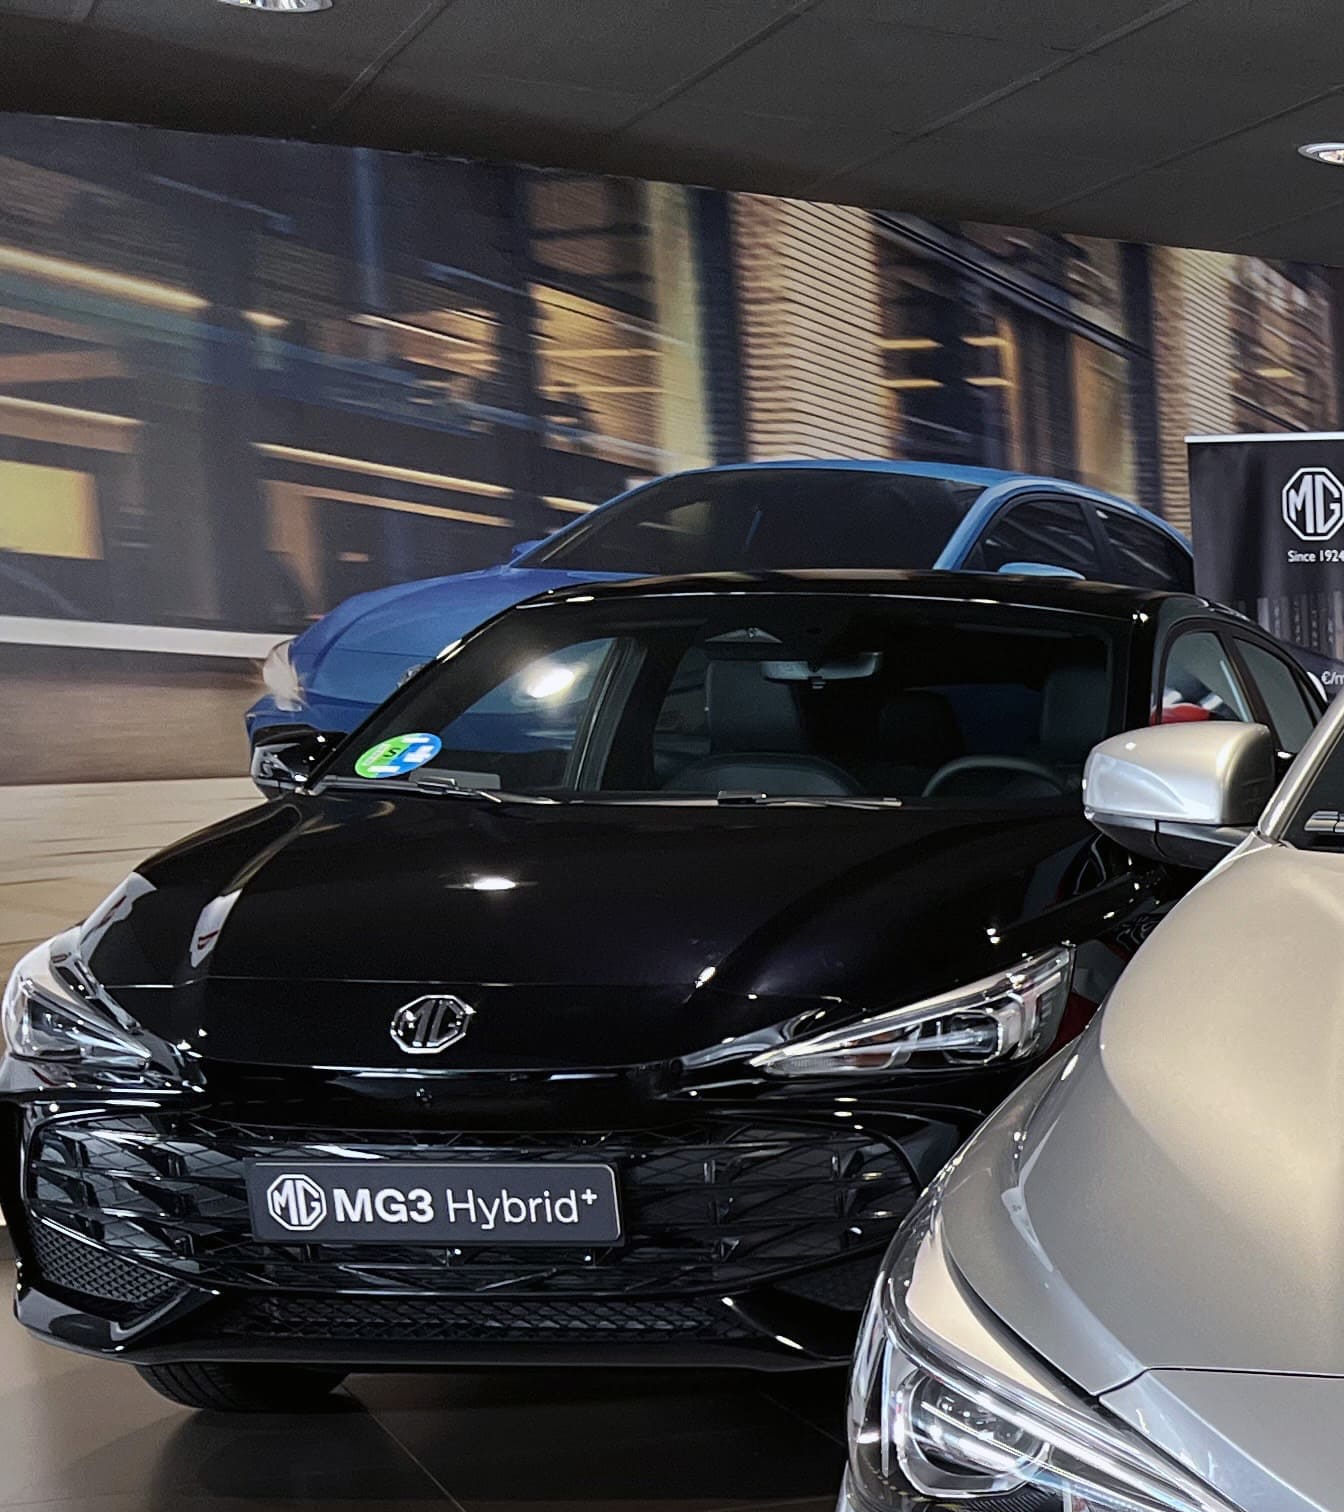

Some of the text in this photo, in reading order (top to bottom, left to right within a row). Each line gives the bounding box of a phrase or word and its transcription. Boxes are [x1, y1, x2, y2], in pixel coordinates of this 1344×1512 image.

[1288, 474, 1341, 534] MG
[1287, 549, 1317, 562] Since
[397, 999, 464, 1048] MG
[272, 1179, 598, 1229] MG MG3 Hybrid+
